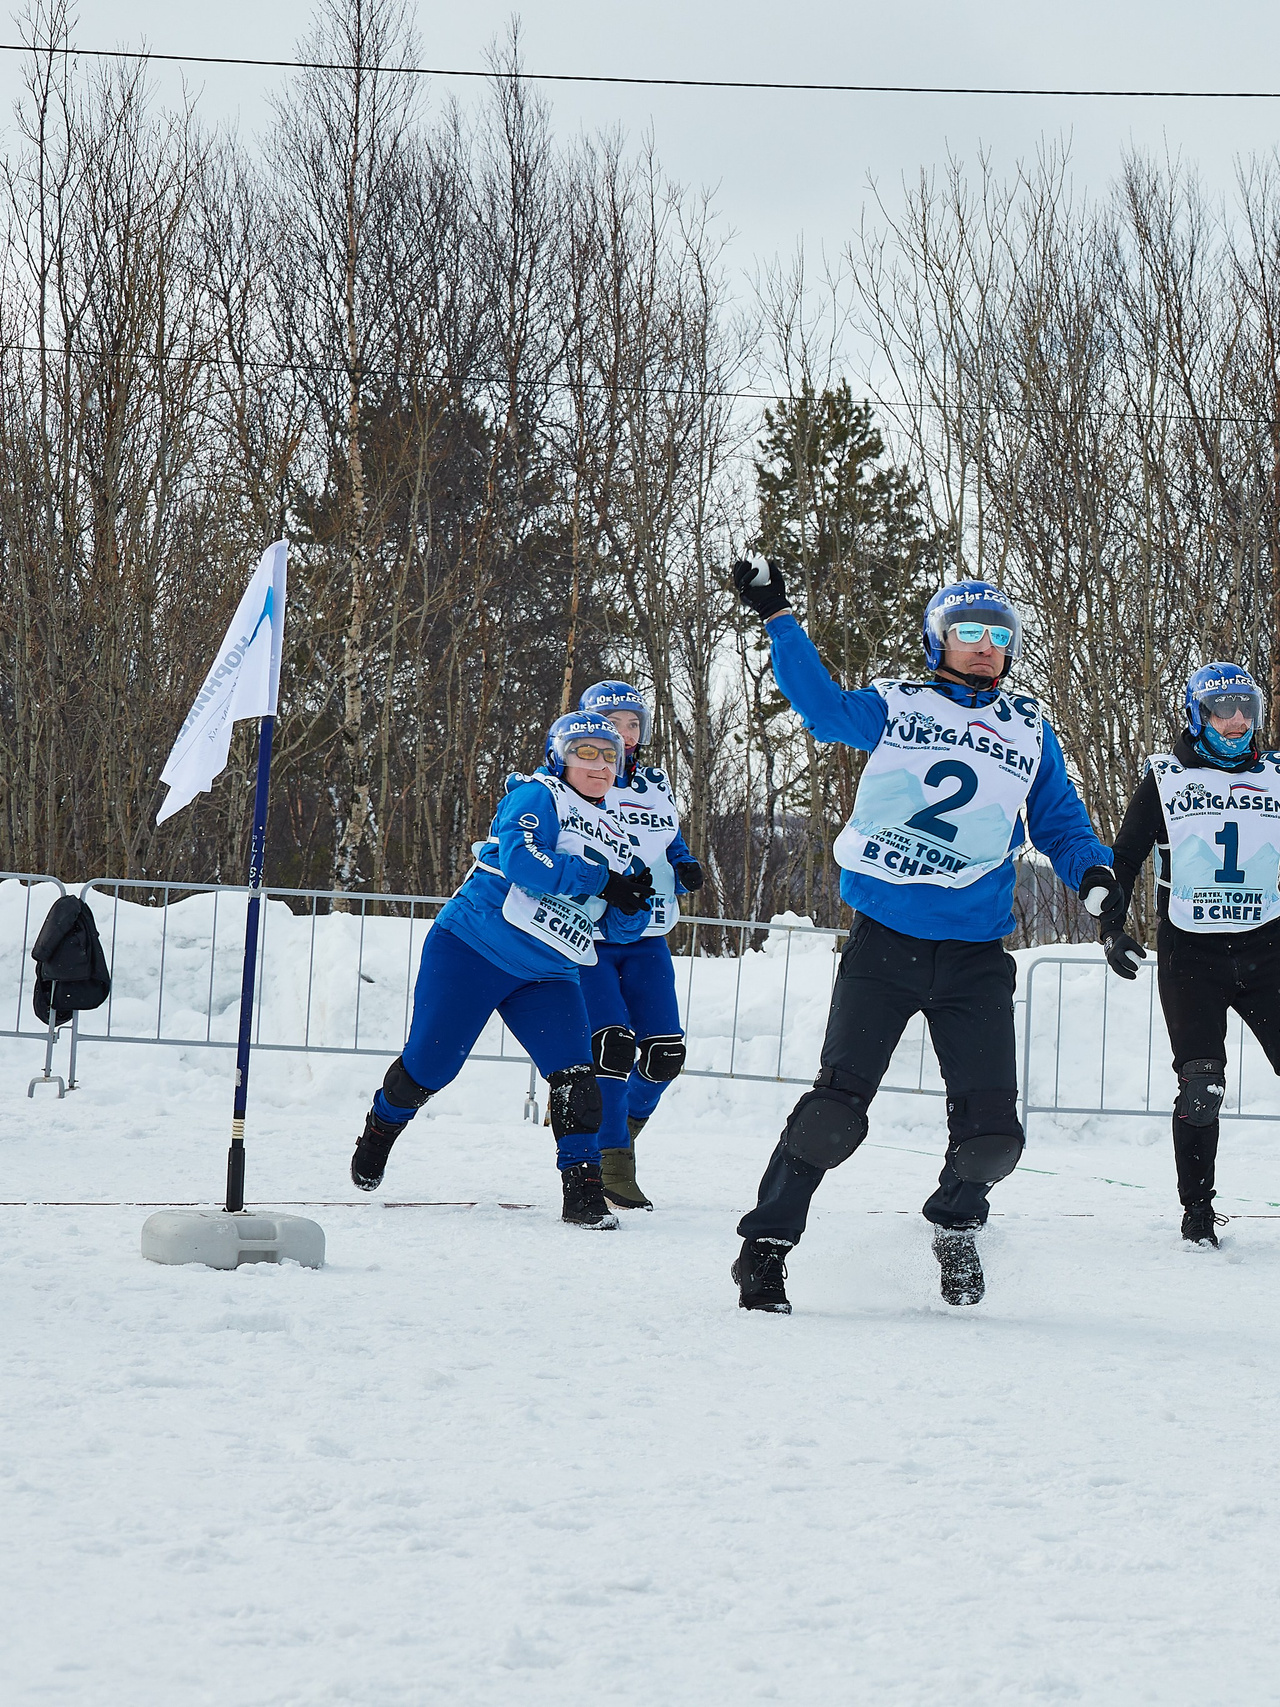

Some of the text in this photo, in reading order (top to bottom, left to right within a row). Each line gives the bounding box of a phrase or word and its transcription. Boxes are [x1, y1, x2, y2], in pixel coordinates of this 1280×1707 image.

[904, 759, 978, 843] 2
[862, 840, 881, 860] В
[1214, 822, 1246, 884] 1
[1193, 905, 1262, 921] В СНЕГЕ
[1224, 892, 1263, 905] ТОЛК
[533, 907, 591, 953] В СНЕГЕ
